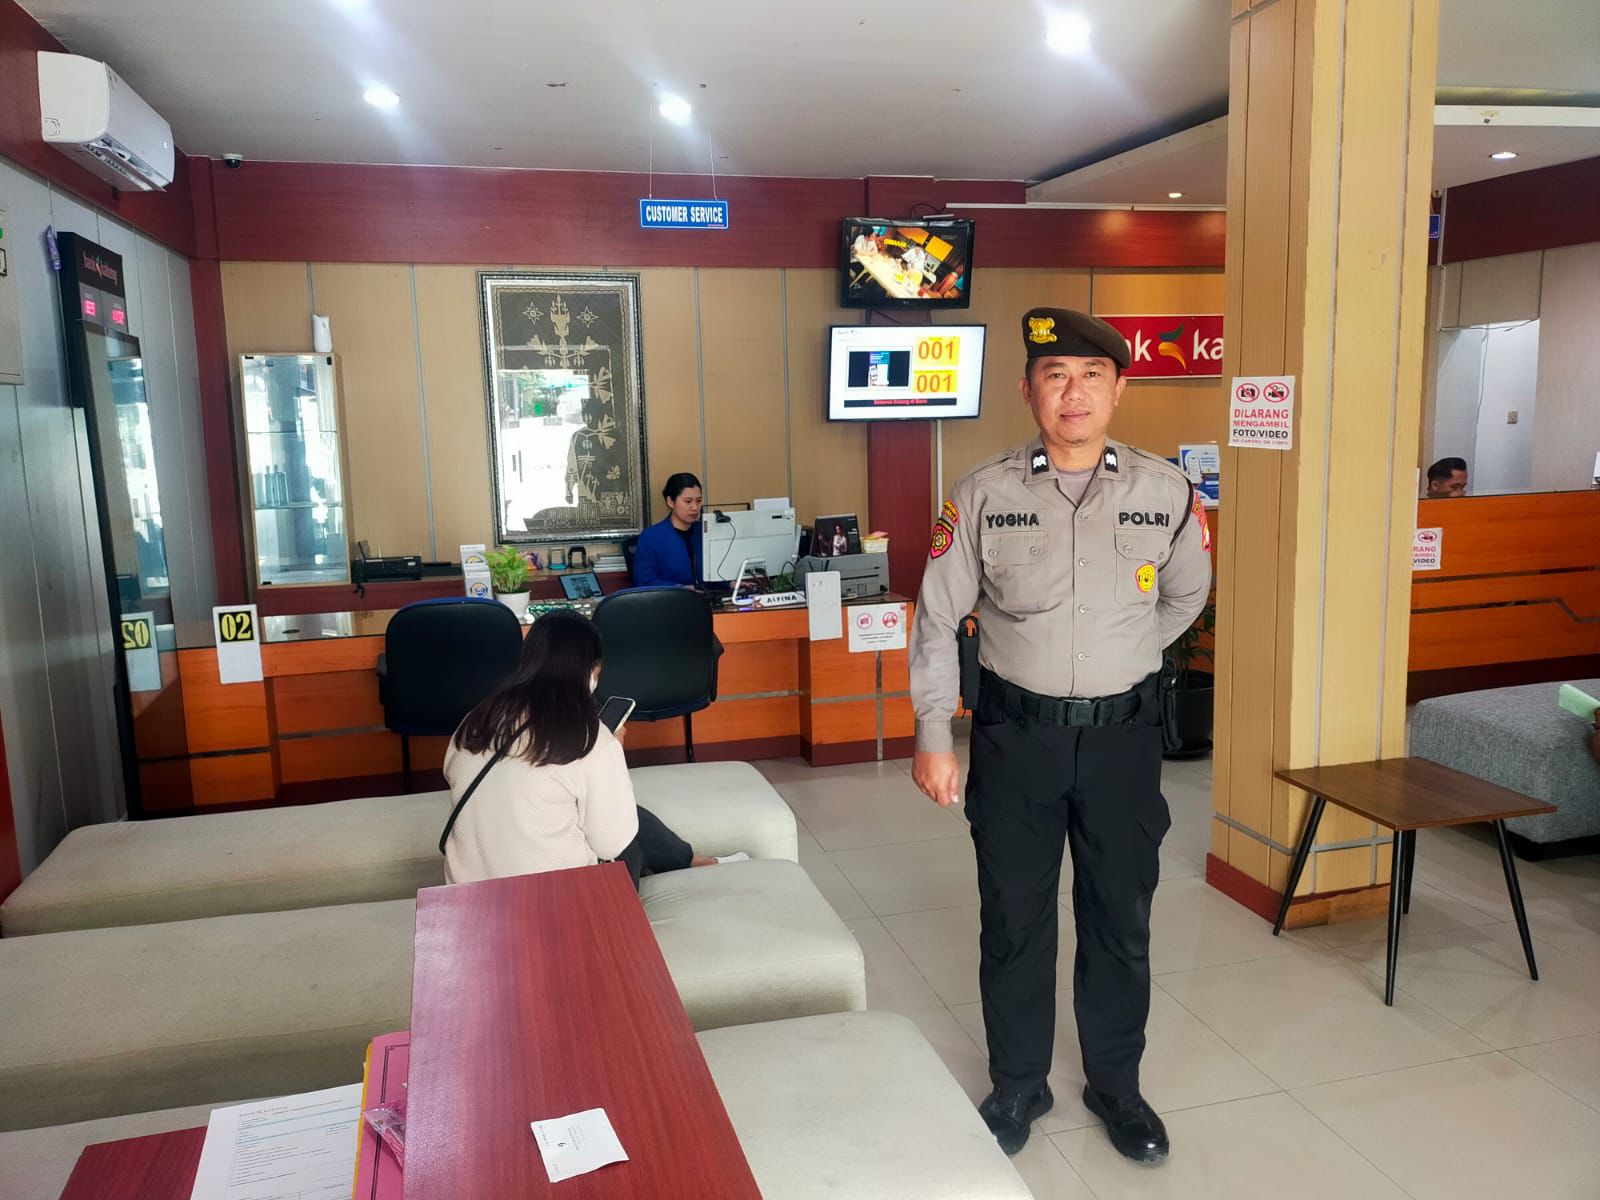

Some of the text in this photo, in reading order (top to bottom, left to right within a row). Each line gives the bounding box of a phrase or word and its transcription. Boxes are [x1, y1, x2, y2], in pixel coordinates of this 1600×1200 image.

[645, 205, 723, 223] CUSTOMER SERVICE
[918, 340, 953, 360] 001
[916, 373, 951, 393] 001
[1234, 408, 1289, 419] DILARANG
[1233, 420, 1289, 428] MENGAMBIL
[1233, 429, 1288, 438] FOTO/VIDEO
[985, 512, 1040, 529] YOGHA
[1119, 511, 1170, 527] POLRI
[766, 594, 798, 604] ALFINA
[221, 613, 251, 640] 02
